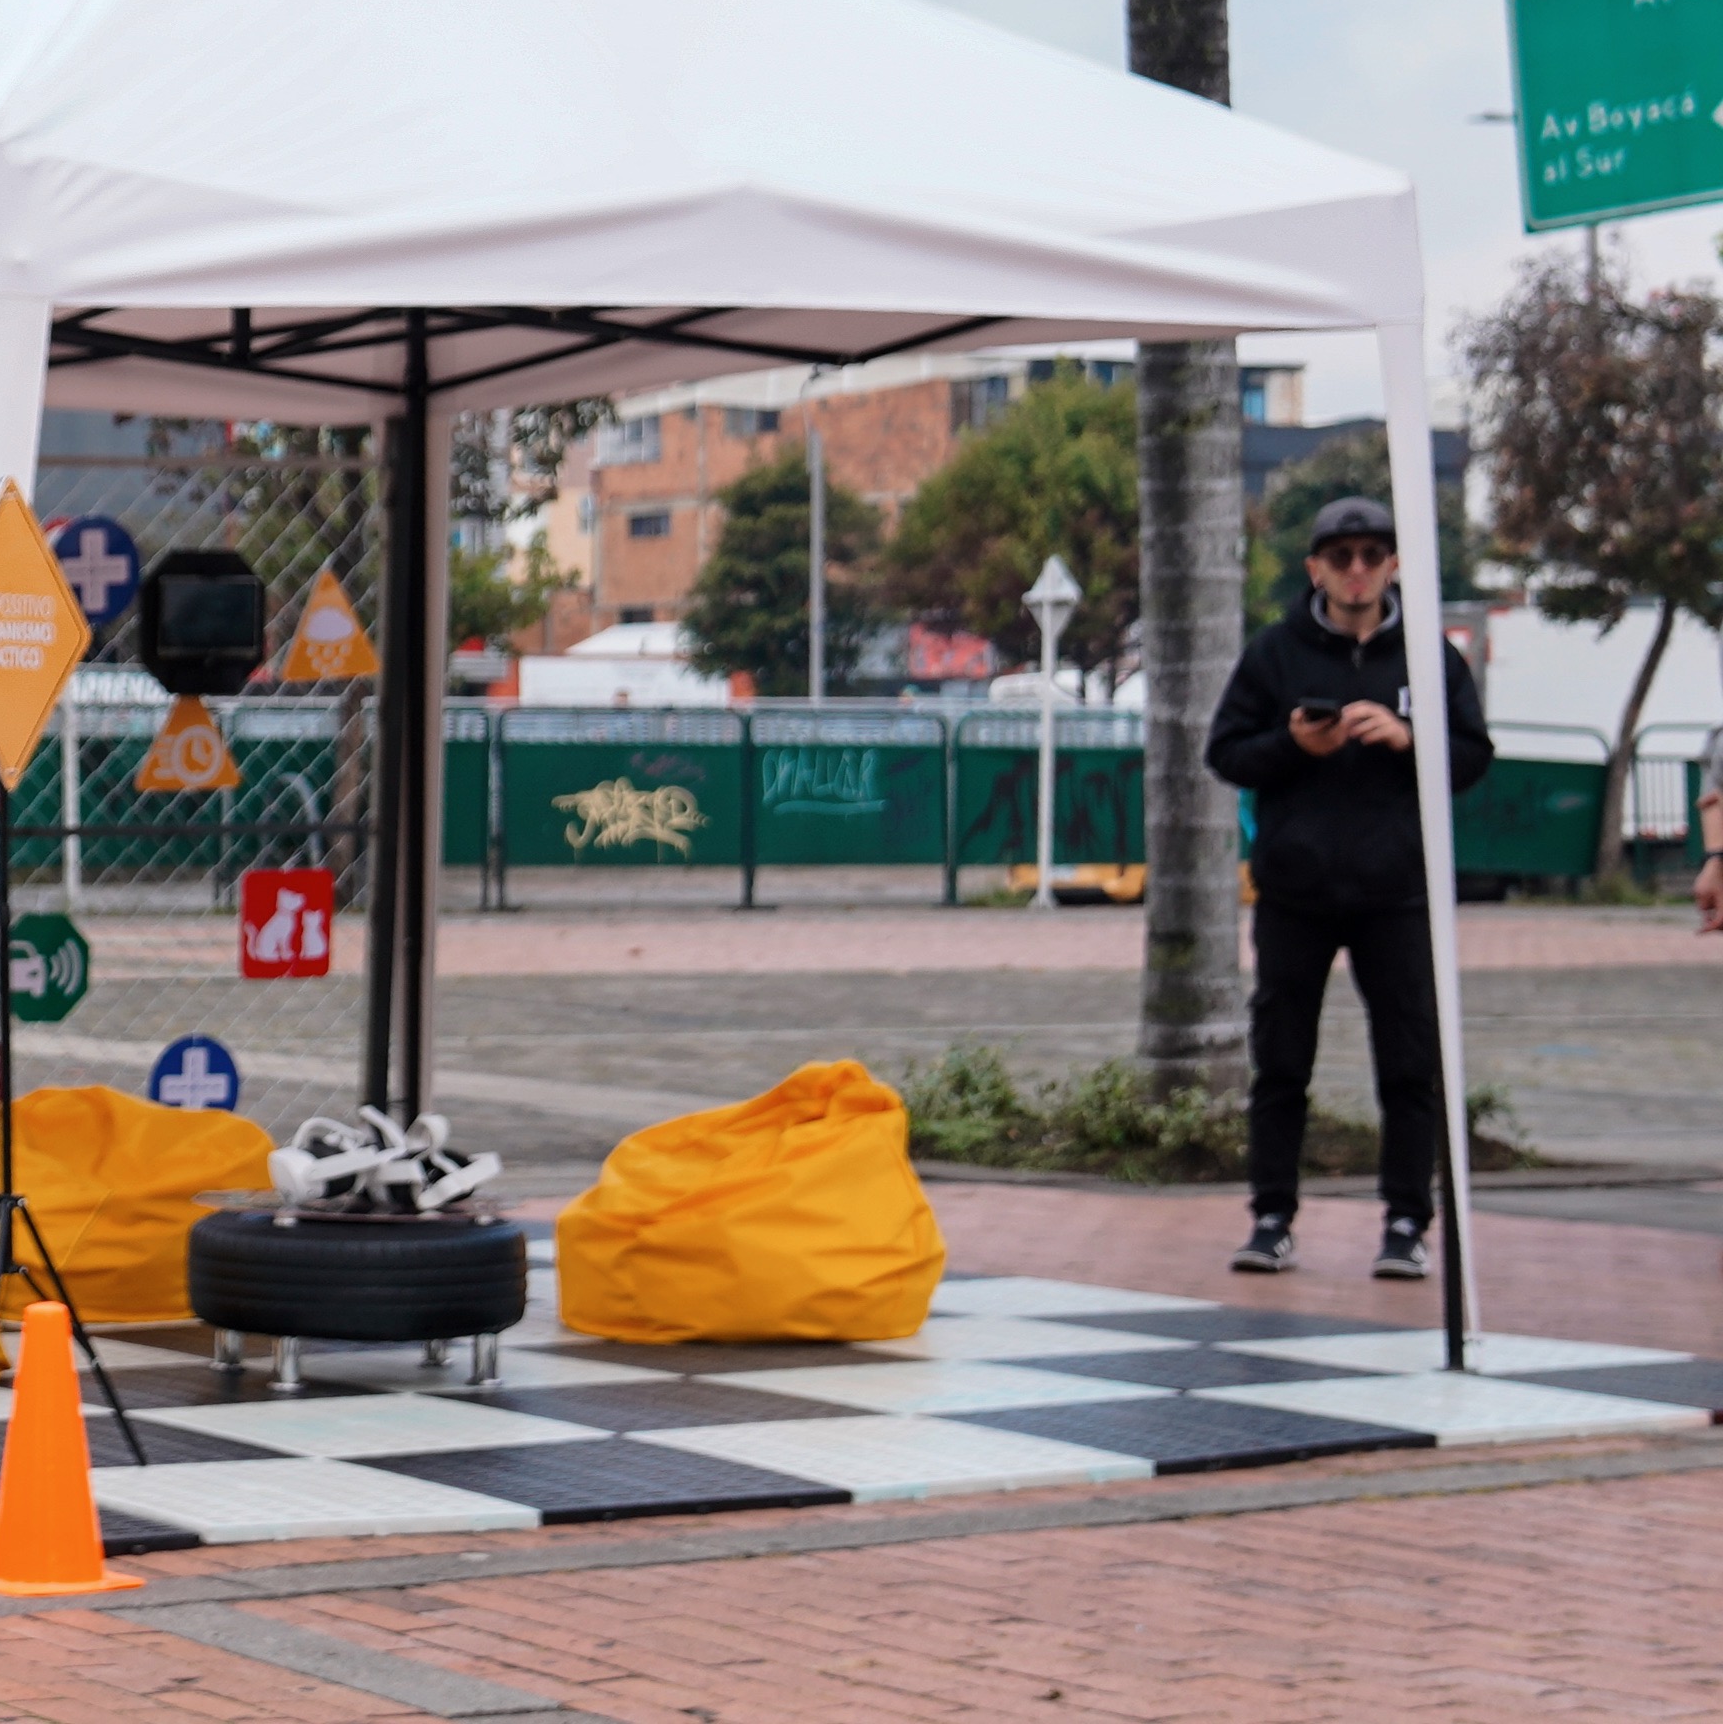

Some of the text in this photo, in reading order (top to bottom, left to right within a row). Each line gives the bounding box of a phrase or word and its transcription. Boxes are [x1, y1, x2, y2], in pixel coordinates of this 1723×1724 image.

[1541, 84, 1696, 142] Av Boyacá
[1543, 145, 1627, 185] al Sur
